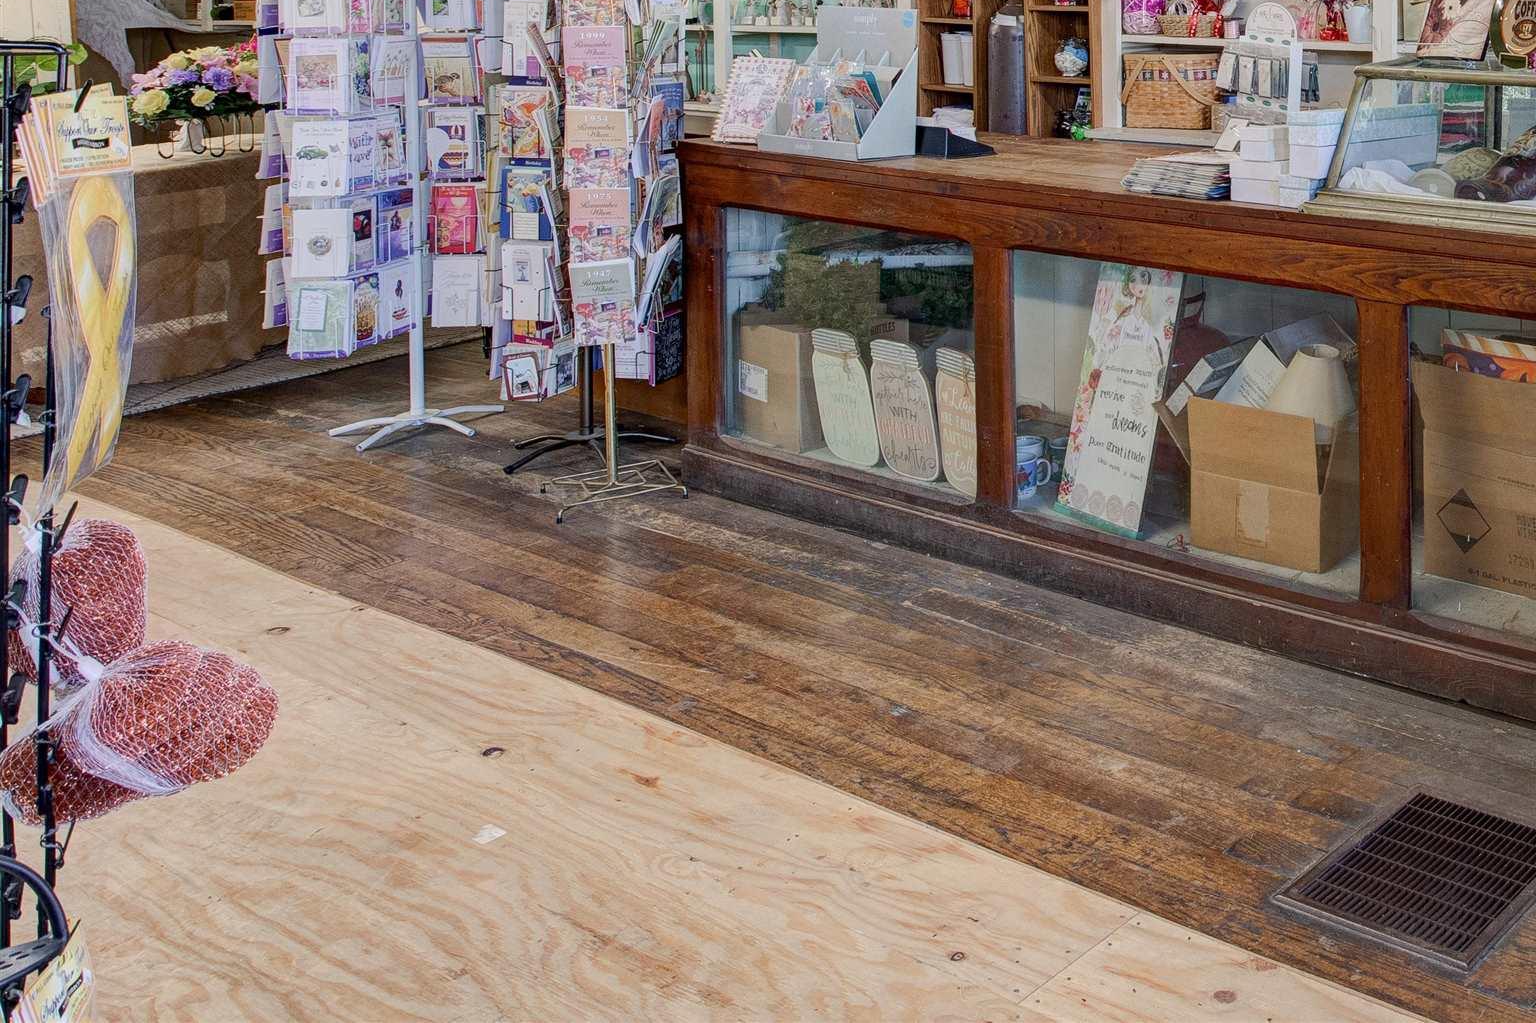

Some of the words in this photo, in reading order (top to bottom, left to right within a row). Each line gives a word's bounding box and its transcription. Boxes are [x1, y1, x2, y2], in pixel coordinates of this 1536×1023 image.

[1099, 389, 1126, 403] revive
[889, 406, 918, 423] WITH
[1111, 410, 1148, 439] dreams
[1106, 440, 1147, 464] gratitude
[1502, 575, 1536, 591] PLASTIC
